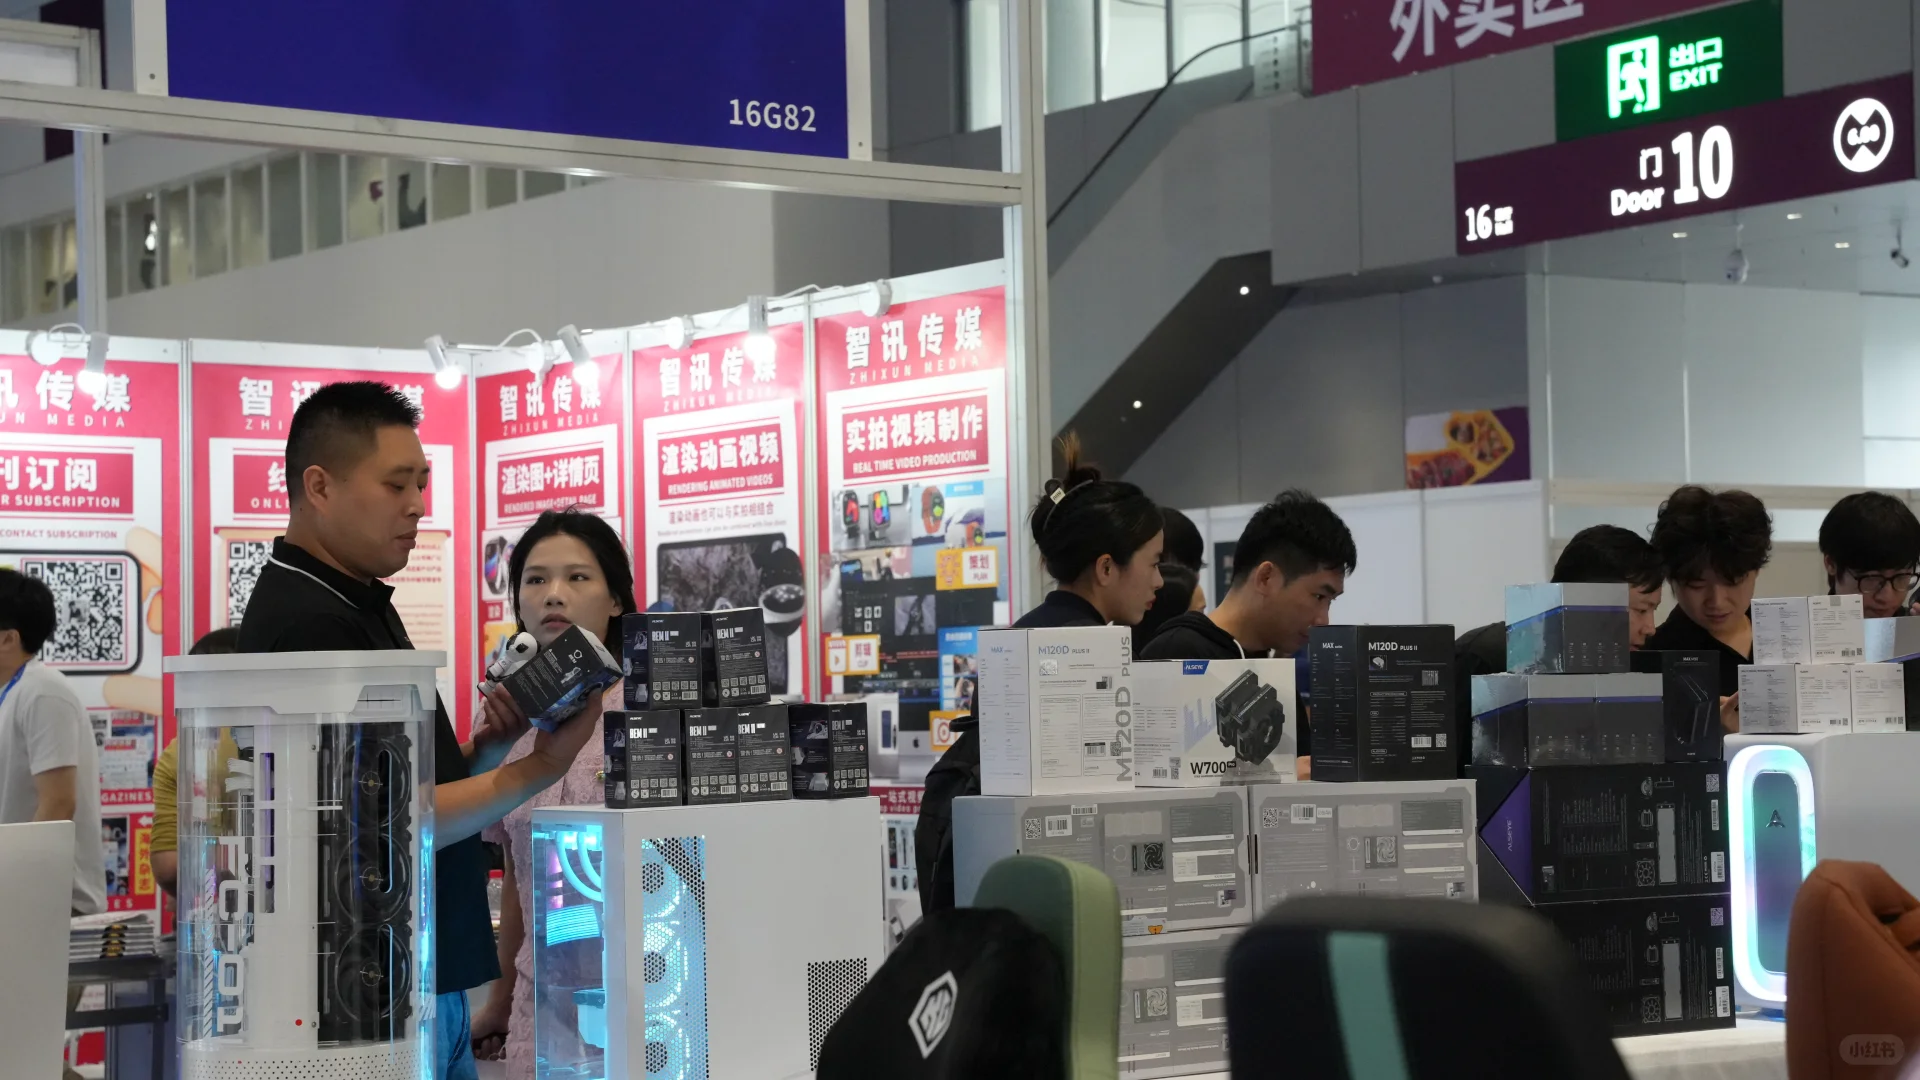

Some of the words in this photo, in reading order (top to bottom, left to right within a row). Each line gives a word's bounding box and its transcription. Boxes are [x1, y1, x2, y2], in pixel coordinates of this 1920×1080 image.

[1669, 37, 1723, 68] 出口
[1669, 62, 1723, 91] EXIT
[730, 99, 817, 132] 16G82
[1671, 125, 1734, 204] 10
[1611, 187, 1665, 216] Door
[846, 306, 983, 369] 智讯传媒
[849, 364, 912, 385] ZHIXUN
[924, 357, 980, 374] MEDIA
[47, 414, 125, 428] MEDIA
[557, 412, 599, 428] MEDIA
[846, 404, 984, 454] 实拍视频制作
[661, 431, 780, 477] 渲染动画视频
[853, 460, 873, 474] REAL
[874, 458, 894, 472] TIME
[895, 455, 921, 470] VIDEO
[922, 450, 977, 467] PRODUCTION
[502, 455, 600, 495] 渲染图+详情页
[668, 481, 709, 496] RENDERING
[709, 476, 746, 491] ANIMATED
[746, 473, 774, 487] VIDEOS
[15, 494, 120, 509] SUBSCRIPTION
[46, 529, 118, 540] SUBSCRIPTION
[1038, 645, 1070, 655] M120D
[1121, 636, 1131, 677] PLUS
[1368, 642, 1398, 651] M120D
[1190, 761, 1227, 775] W700
